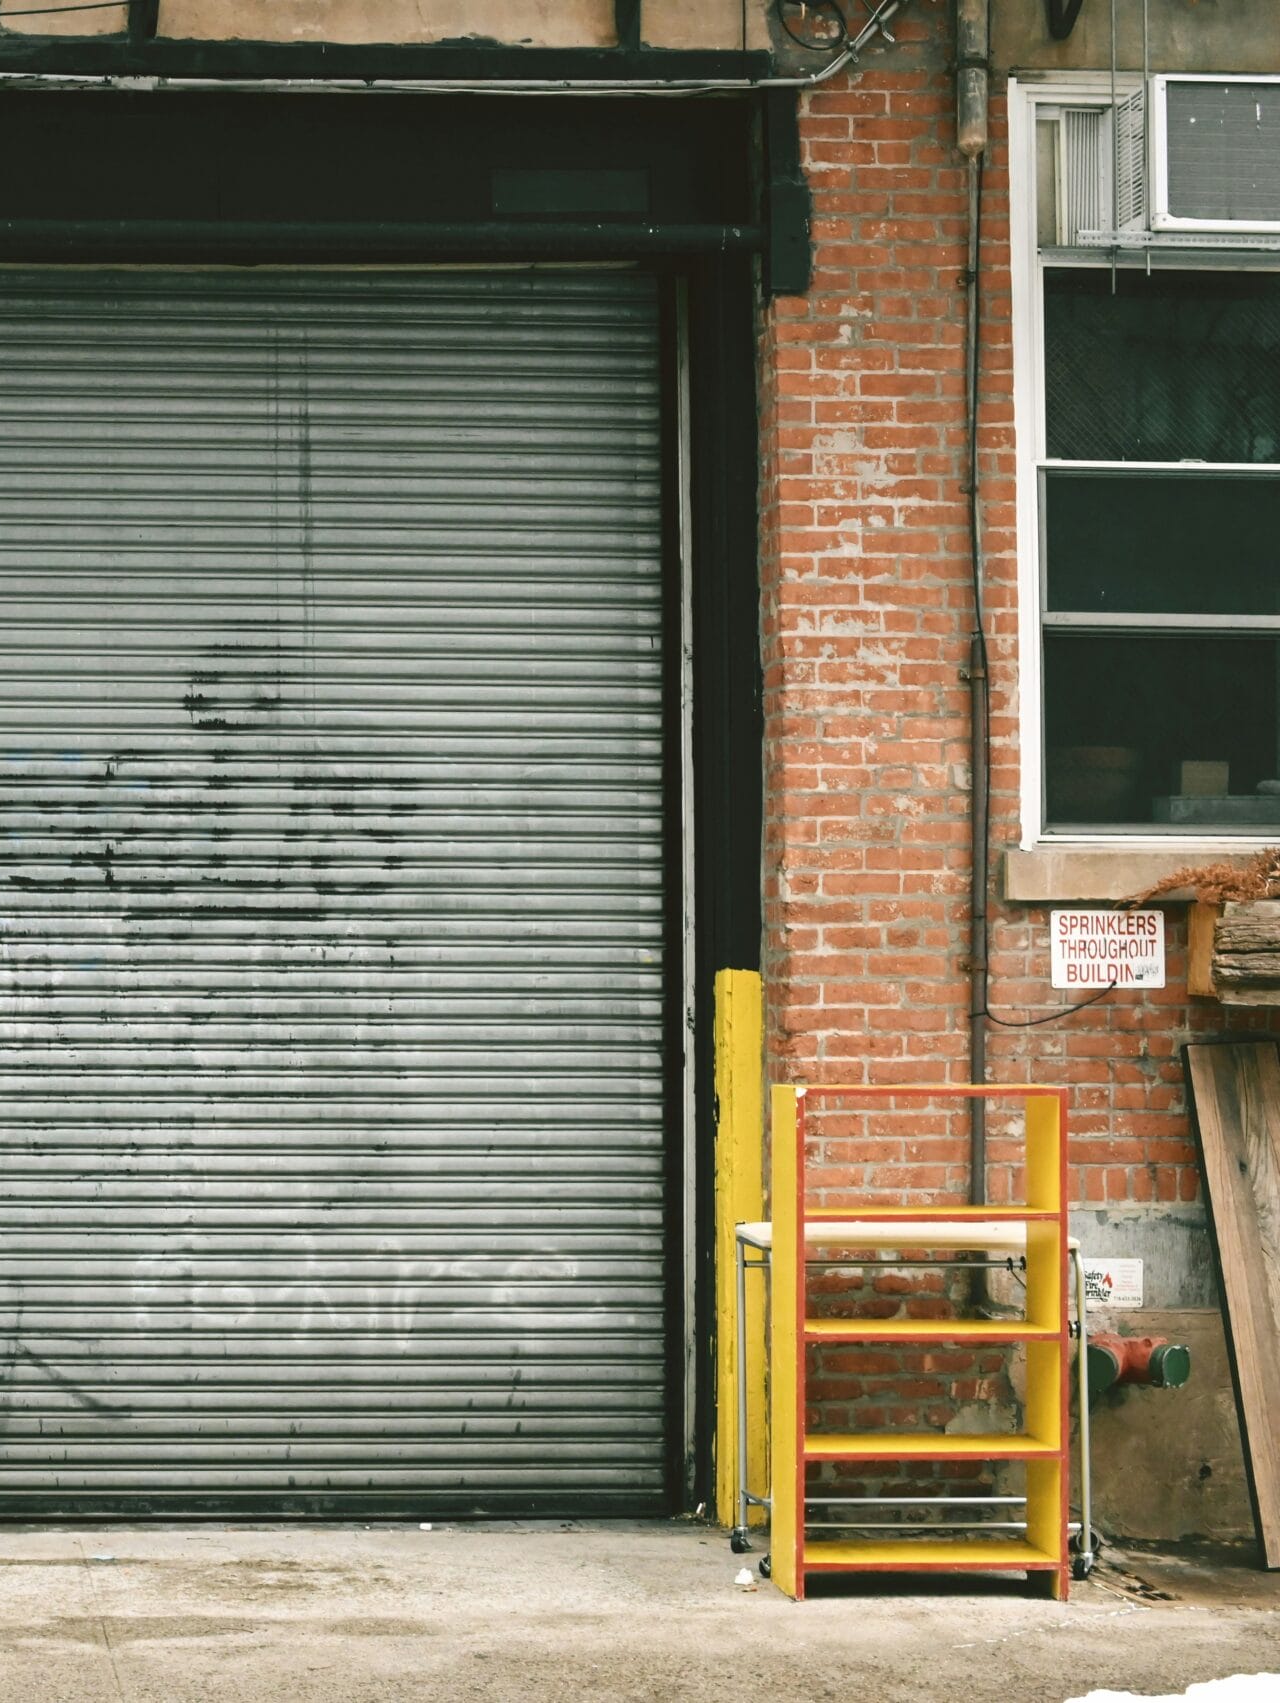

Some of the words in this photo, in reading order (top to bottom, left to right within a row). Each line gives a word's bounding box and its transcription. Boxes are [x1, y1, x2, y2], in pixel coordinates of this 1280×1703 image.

[1059, 915, 1157, 935] SPRINKLERS
[1059, 939, 1157, 959] THROUGHOUT
[1067, 963, 1136, 982] BUILDIN
